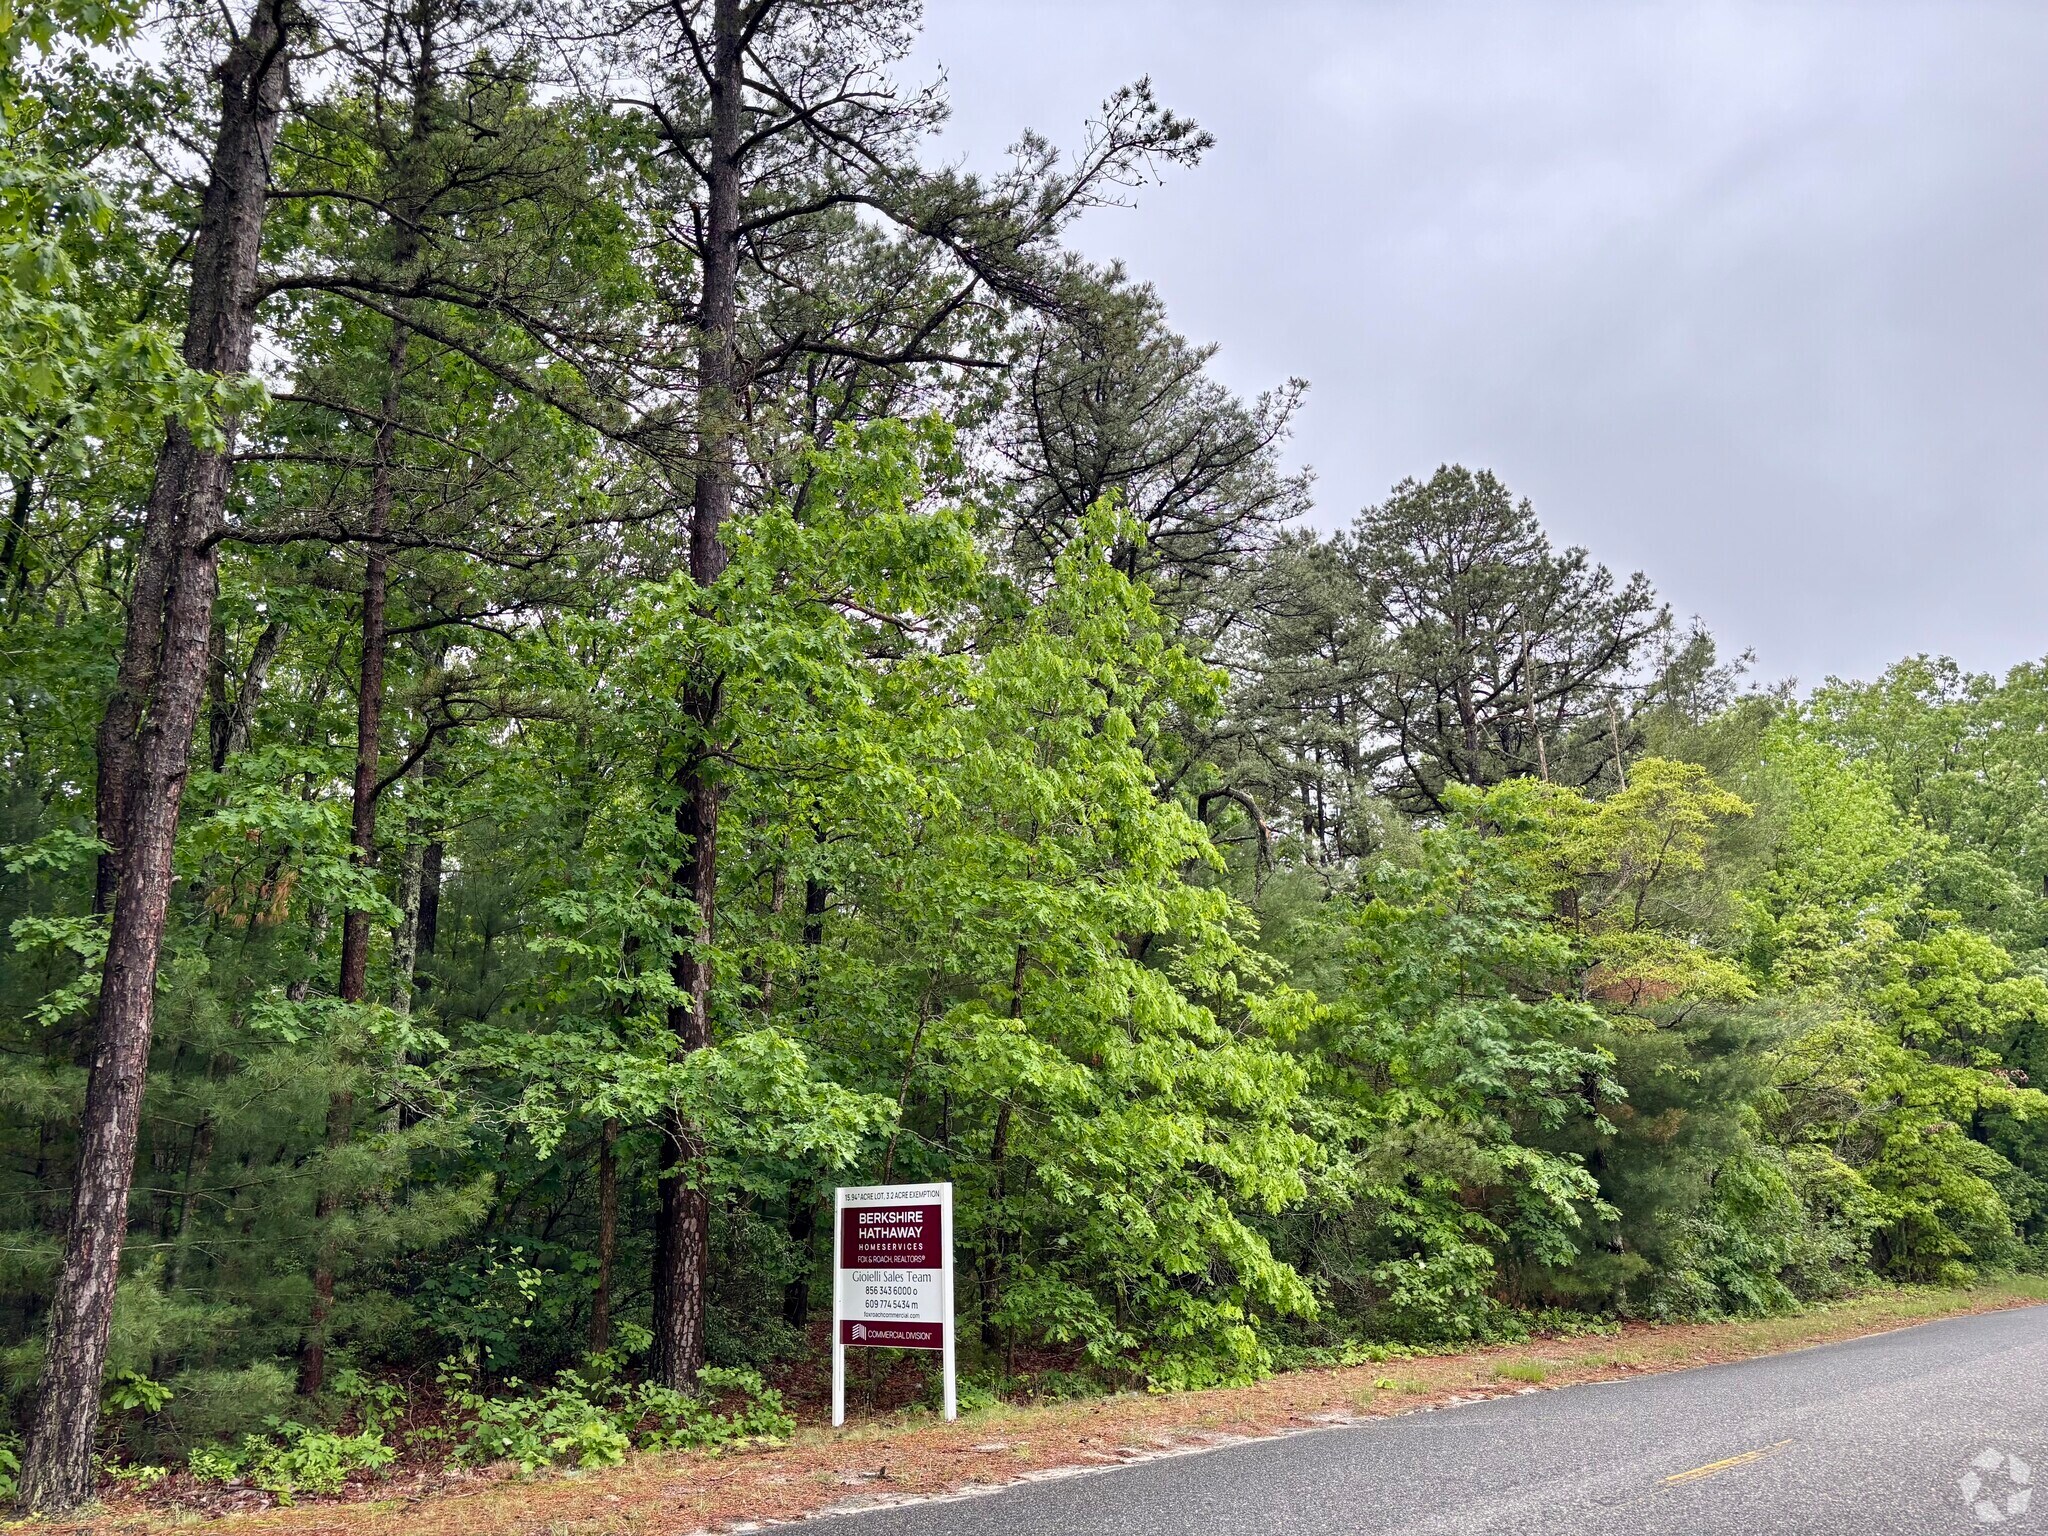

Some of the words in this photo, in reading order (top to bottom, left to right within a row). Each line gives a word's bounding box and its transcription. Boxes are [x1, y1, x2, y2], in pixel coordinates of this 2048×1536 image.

[860, 1192, 873, 1201] ACRE
[874, 1192, 886, 1200] LOT,
[895, 1191, 908, 1199] ACRE
[909, 1190, 940, 1198] EXEMPTION
[859, 1211, 923, 1224] BERKSHIRE
[858, 1226, 923, 1239] HATHAWAY
[858, 1242, 924, 1251] HOMESERVICES
[873, 1256, 893, 1264] ROACH,
[852, 1270, 880, 1282] Gioielli
[884, 1271, 904, 1282] Sales
[906, 1271, 932, 1282] Team
[866, 1286, 878, 1295] 856
[880, 1286, 892, 1296] 343
[893, 1286, 912, 1296] 6000
[865, 1300, 878, 1308] 609
[880, 1300, 892, 1308] 774
[893, 1300, 910, 1309] 5434
[868, 1330, 905, 1340] COMMERCIAL
